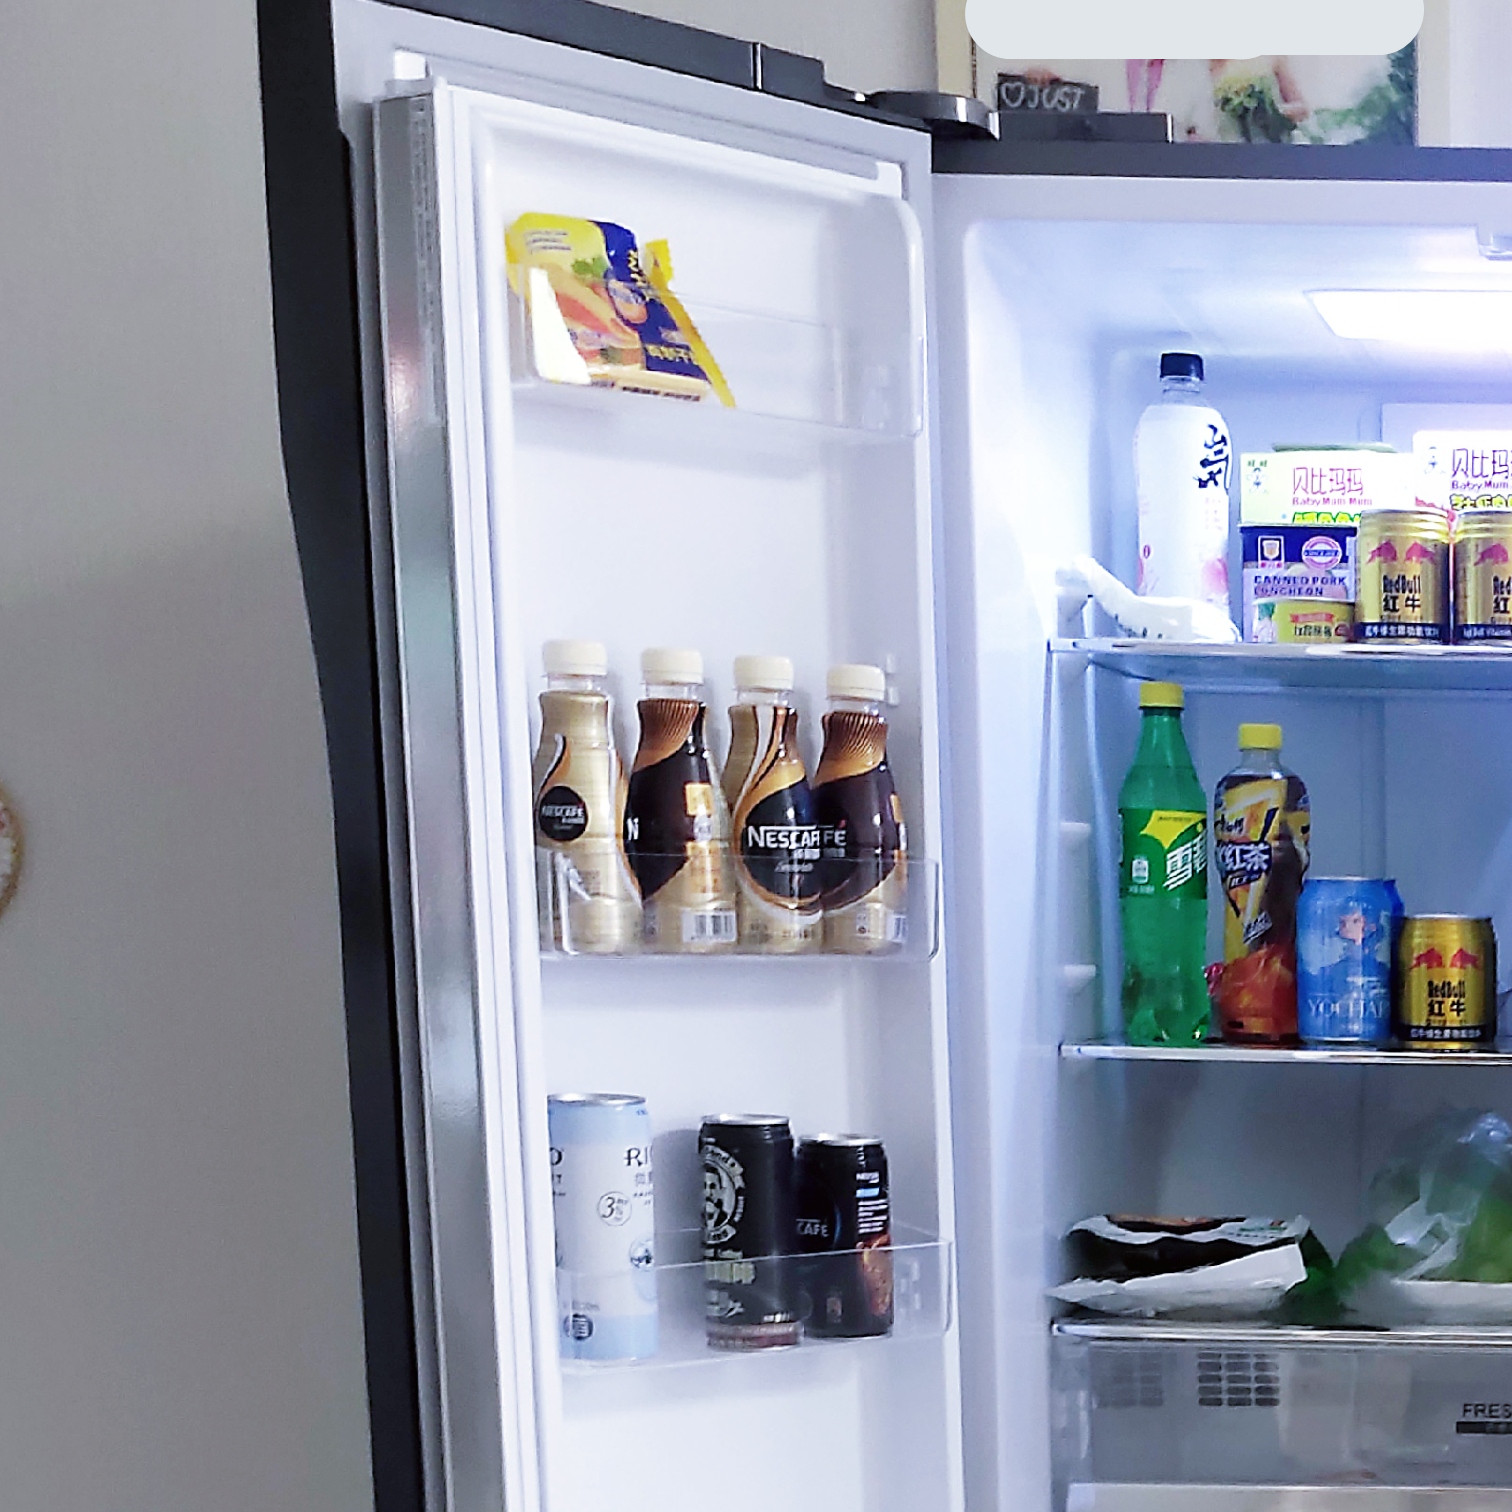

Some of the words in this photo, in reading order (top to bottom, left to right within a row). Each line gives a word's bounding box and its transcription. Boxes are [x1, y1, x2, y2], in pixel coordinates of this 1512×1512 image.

[1027, 84, 1085, 113] JUST
[1293, 467, 1364, 496] 贝比玛玛
[1452, 480, 1483, 491] Baby
[1484, 480, 1509, 490] Mum
[1292, 496, 1321, 507] Baby
[1254, 575, 1309, 585] CANNED
[1312, 576, 1347, 586] PORK
[1254, 586, 1324, 597] LUNCHEON
[1383, 595, 1421, 613] 红牛
[1427, 999, 1466, 1017] 红牛
[624, 1147, 653, 1167] RI
